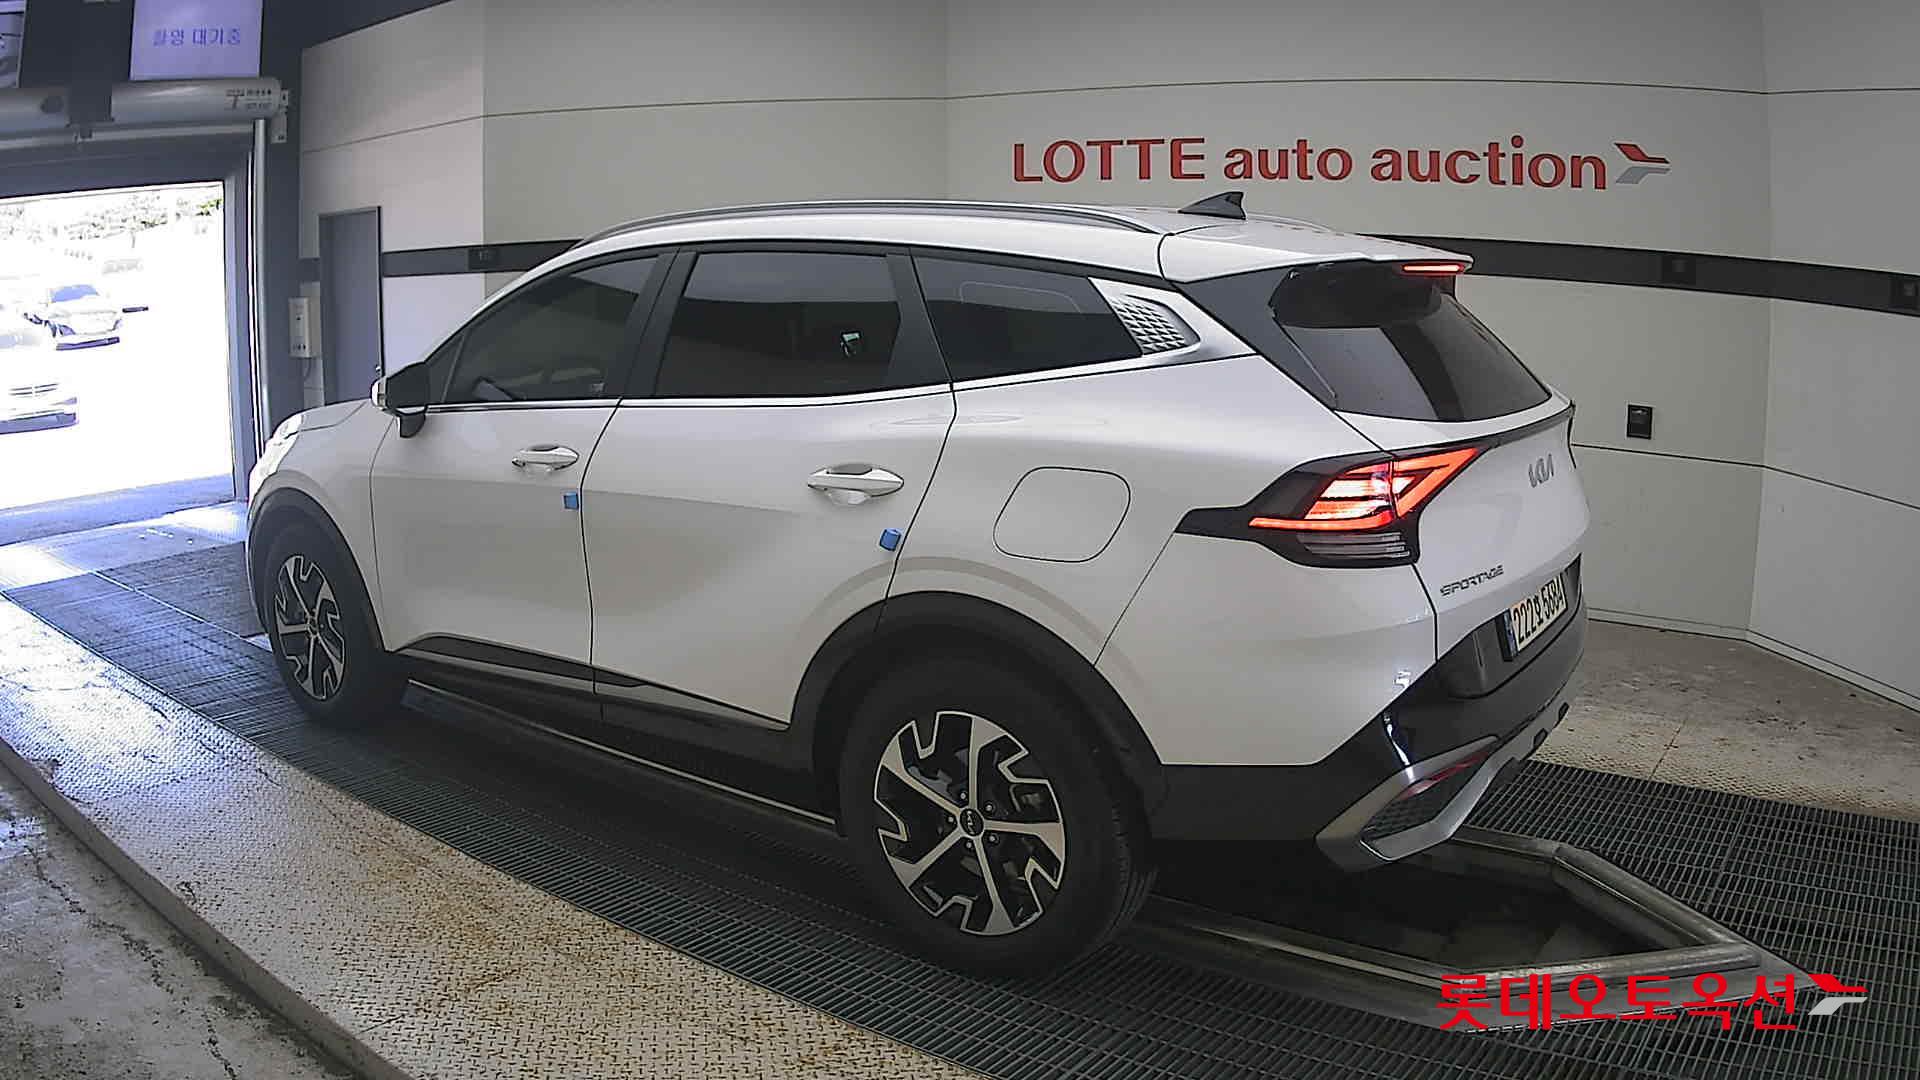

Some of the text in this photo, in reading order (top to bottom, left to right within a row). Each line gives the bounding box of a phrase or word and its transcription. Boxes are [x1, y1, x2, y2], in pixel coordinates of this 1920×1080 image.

[1014, 135, 1608, 190] LOTTE auto auction
[1439, 564, 1505, 596] SPORTAGE
